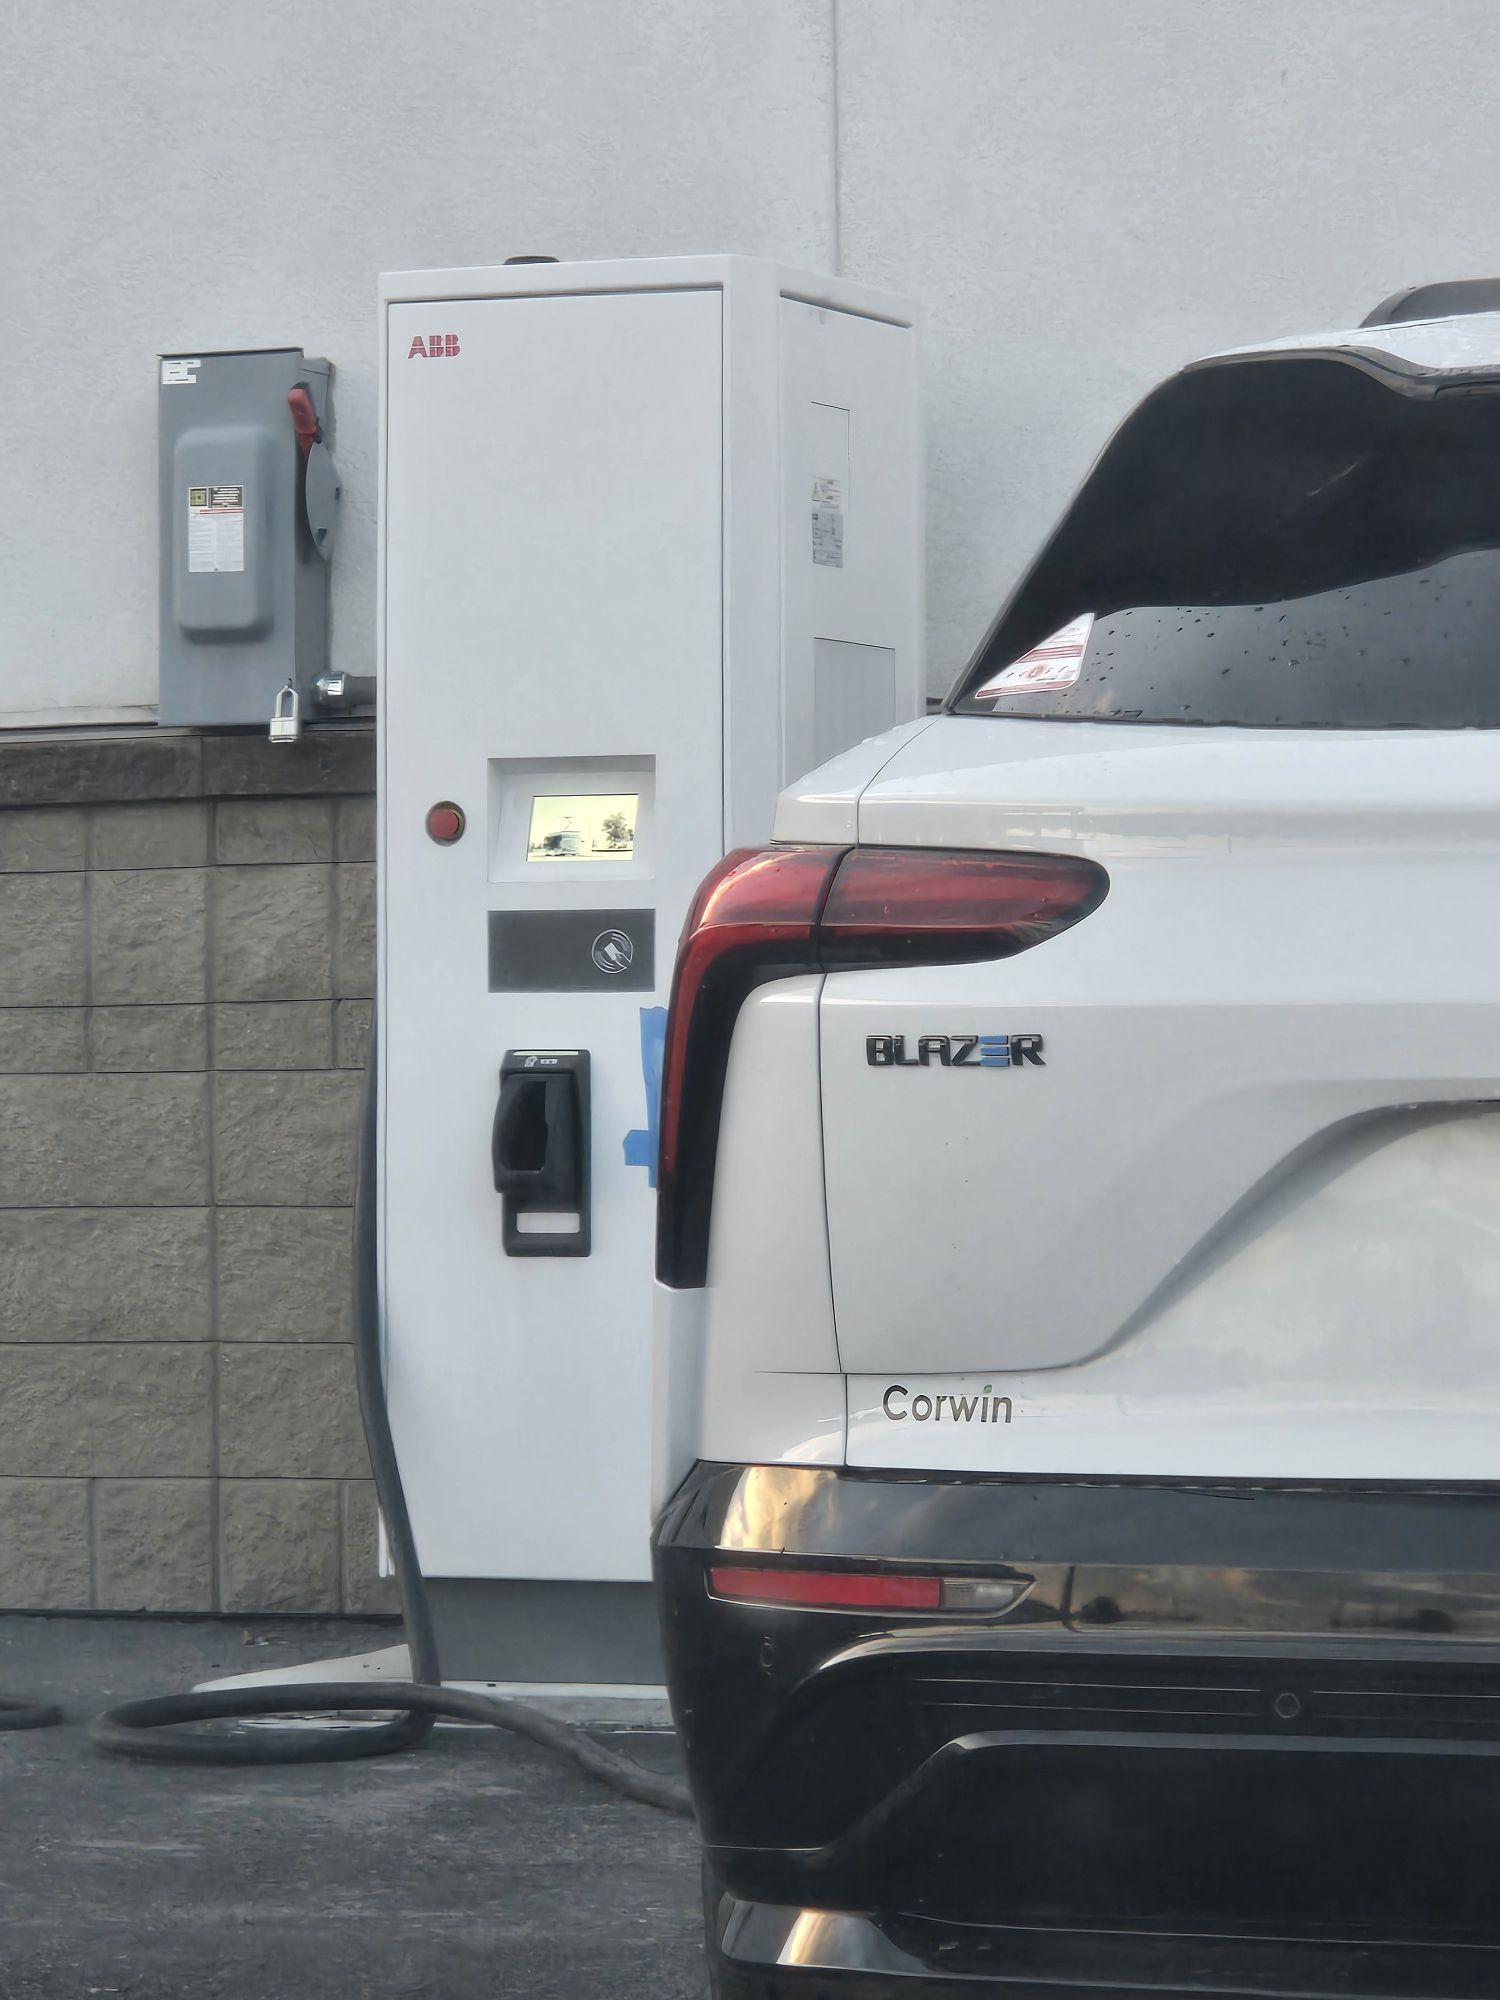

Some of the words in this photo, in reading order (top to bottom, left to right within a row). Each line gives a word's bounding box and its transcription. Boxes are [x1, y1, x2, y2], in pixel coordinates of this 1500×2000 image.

[408, 334, 461, 359] ABB
[866, 1034, 1047, 1067] BLAZER
[882, 1384, 1013, 1423] Corwin
